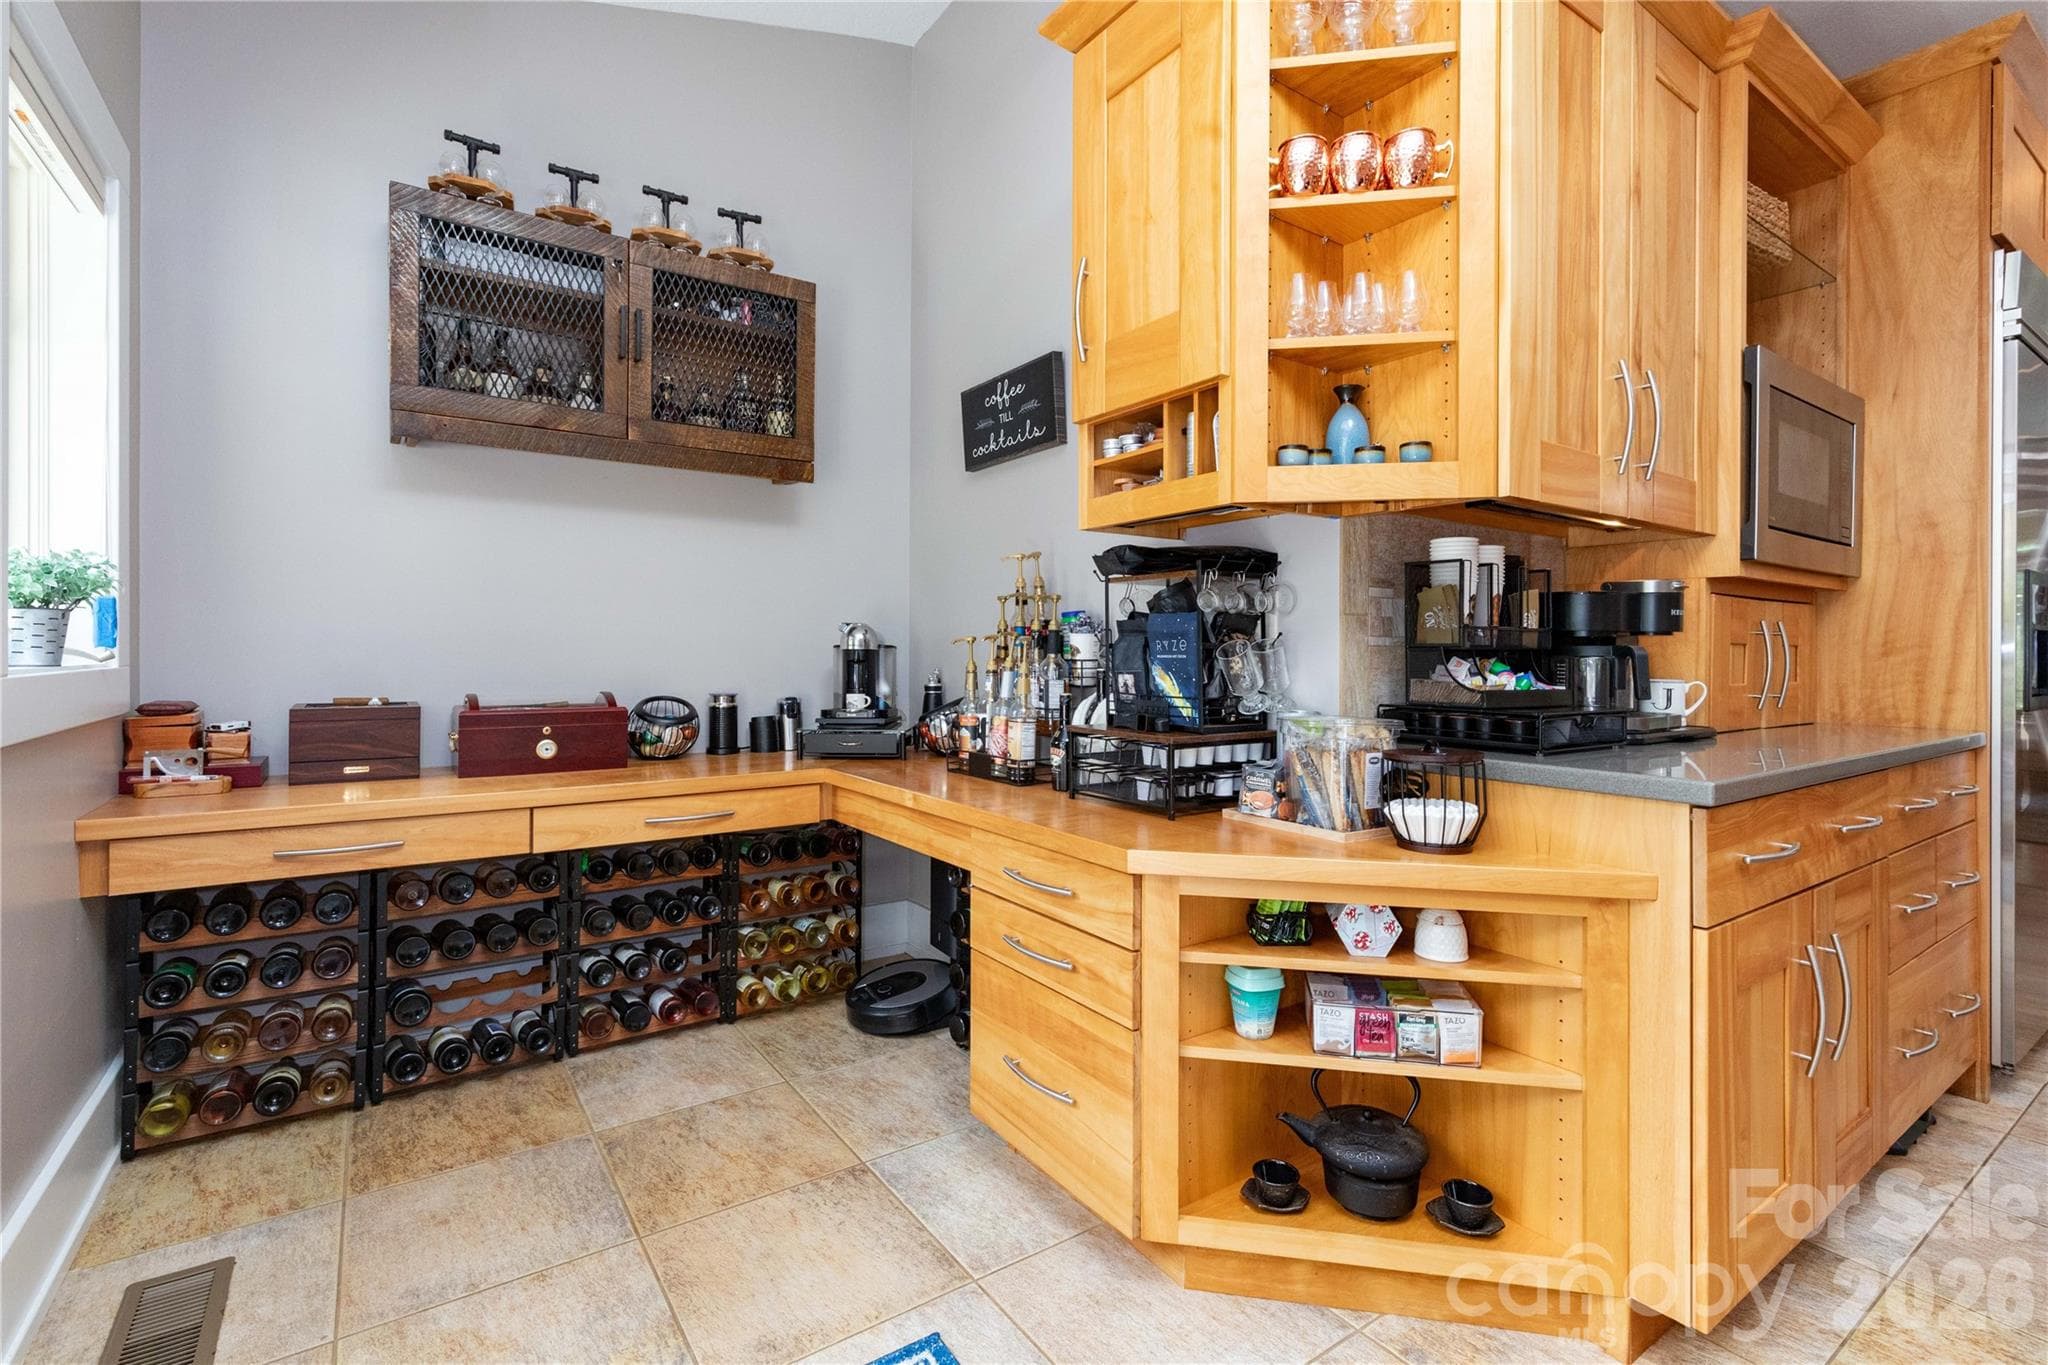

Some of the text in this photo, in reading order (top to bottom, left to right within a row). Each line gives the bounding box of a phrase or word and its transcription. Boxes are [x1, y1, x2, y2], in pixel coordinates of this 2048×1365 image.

[984, 379, 1026, 410] coffee
[998, 411, 1014, 424] TILL
[972, 419, 1047, 458] cocktails
[1313, 989, 1335, 998] TAZO
[1319, 1008, 1342, 1017] TAZO
[1358, 1012, 1389, 1022] STASH
[1359, 1016, 1391, 1036] green
[1444, 1016, 1466, 1025] TAZO
[1364, 1025, 1385, 1043] tea
